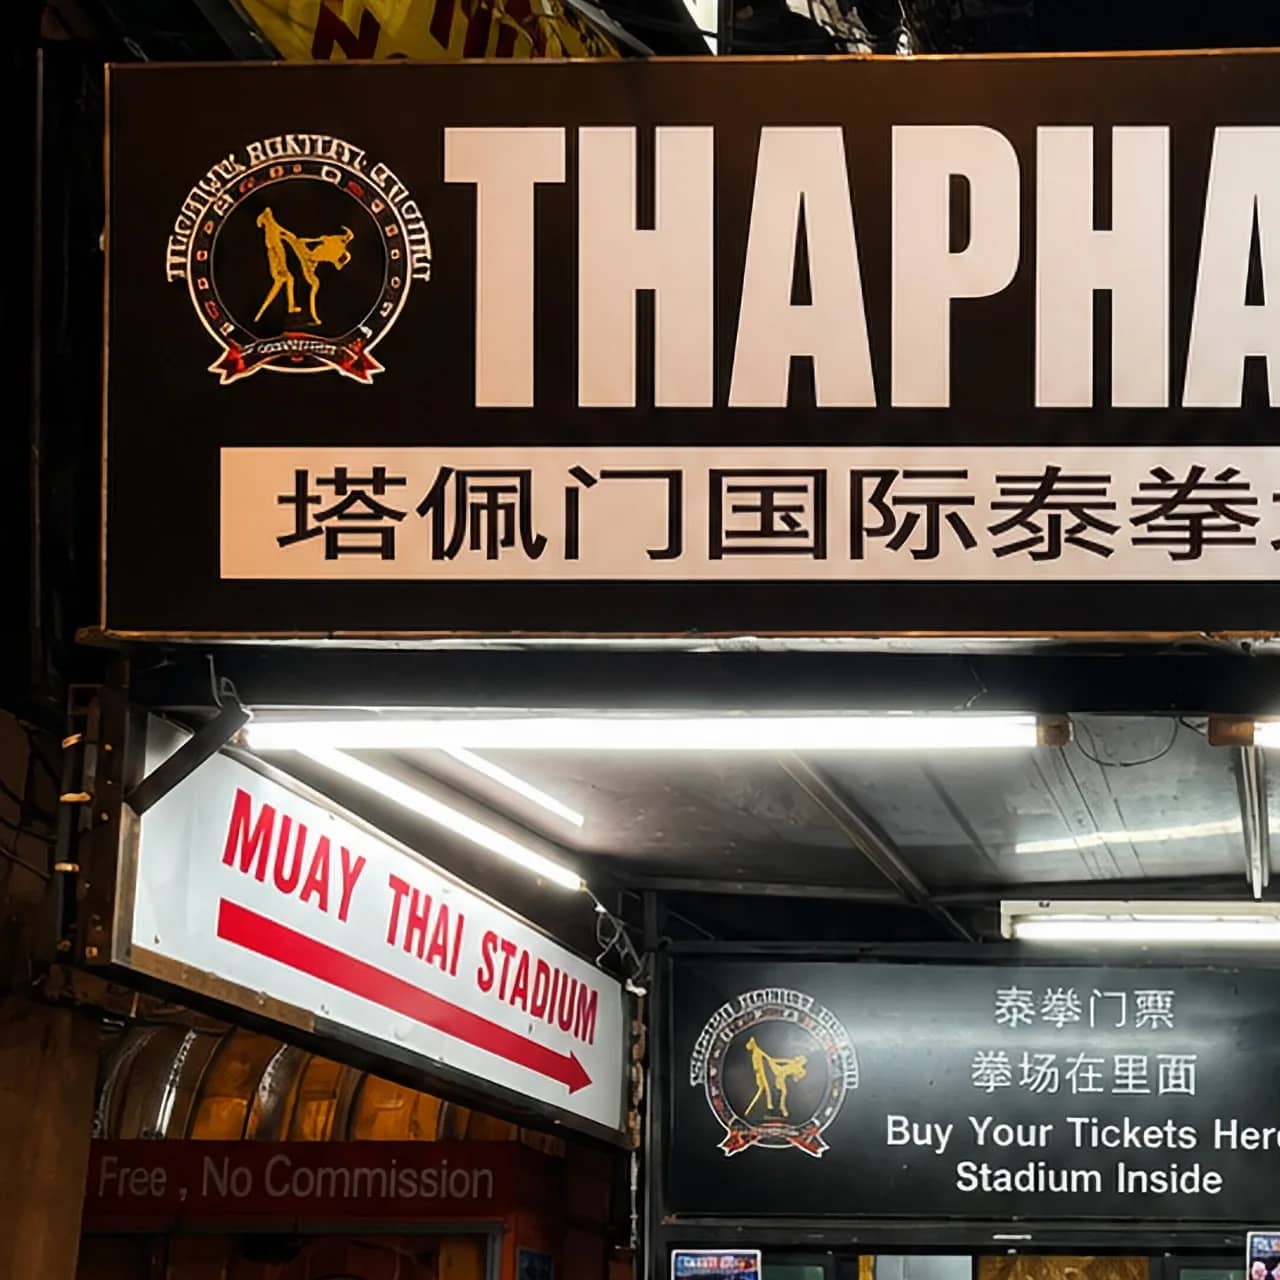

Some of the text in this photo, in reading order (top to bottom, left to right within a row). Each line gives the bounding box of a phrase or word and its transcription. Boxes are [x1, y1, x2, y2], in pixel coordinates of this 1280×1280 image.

[221, 787, 366, 923] MUAY
[386, 873, 465, 977] THAI
[477, 929, 598, 1046] STADIUM
[994, 987, 1174, 1029] 泰拳门票
[970, 1050, 1198, 1096] 拳场在里面
[886, 1116, 954, 1155] Buy
[967, 1117, 1054, 1150] Your
[1065, 1117, 1197, 1152] Tickets
[99, 1156, 167, 1197] Free
[202, 1157, 253, 1197] No
[265, 1155, 494, 1198] Commission
[956, 1162, 1223, 1195] Stadium Inside
